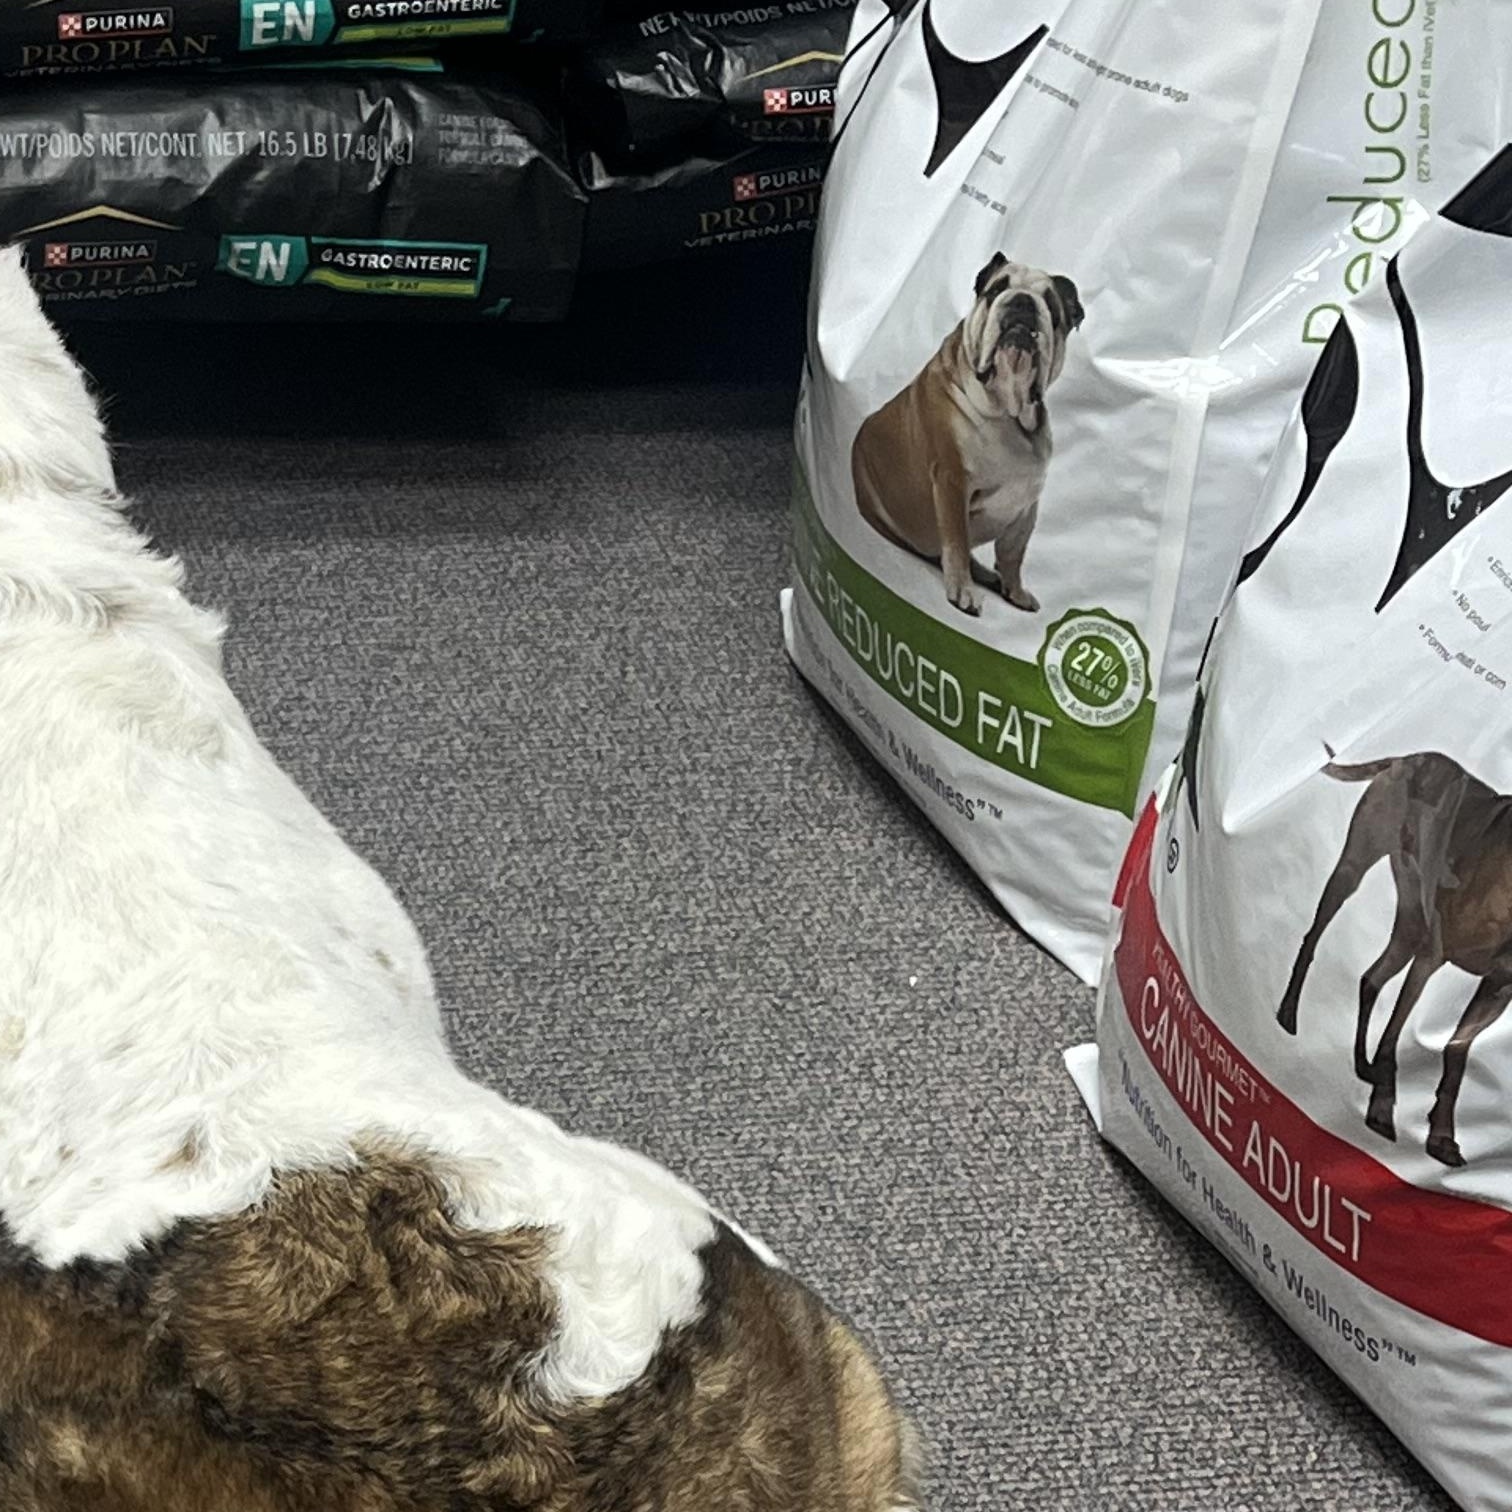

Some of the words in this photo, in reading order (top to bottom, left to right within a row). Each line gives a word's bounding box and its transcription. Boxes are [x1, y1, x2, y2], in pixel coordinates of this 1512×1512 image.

[85, 11, 166, 33] PURINA
[251, 0, 315, 45] EN
[22, 41, 101, 68] PRO
[109, 34, 212, 60] PLAN
[1417, 74, 1432, 99] Fat
[1416, 103, 1431, 140] Less
[0, 131, 96, 158] WT/POIDS
[257, 130, 298, 157] 16.5
[302, 131, 329, 158] LB
[759, 168, 821, 190] PURIN
[697, 200, 776, 233] PRO
[70, 244, 151, 261] PURINA
[227, 241, 291, 282] EN
[320, 248, 473, 272] GASTROENTERIC
[89, 263, 190, 287] PLAN
[827, 572, 964, 728] REDUCED
[977, 690, 1054, 769] FAT
[1070, 641, 1122, 689] 27%
[1140, 976, 1236, 1153] CANINE
[1241, 1120, 1372, 1263] ADULT
[1176, 1145, 1198, 1191] for
[1201, 1176, 1257, 1256] Health
[1261, 1243, 1278, 1277] &
